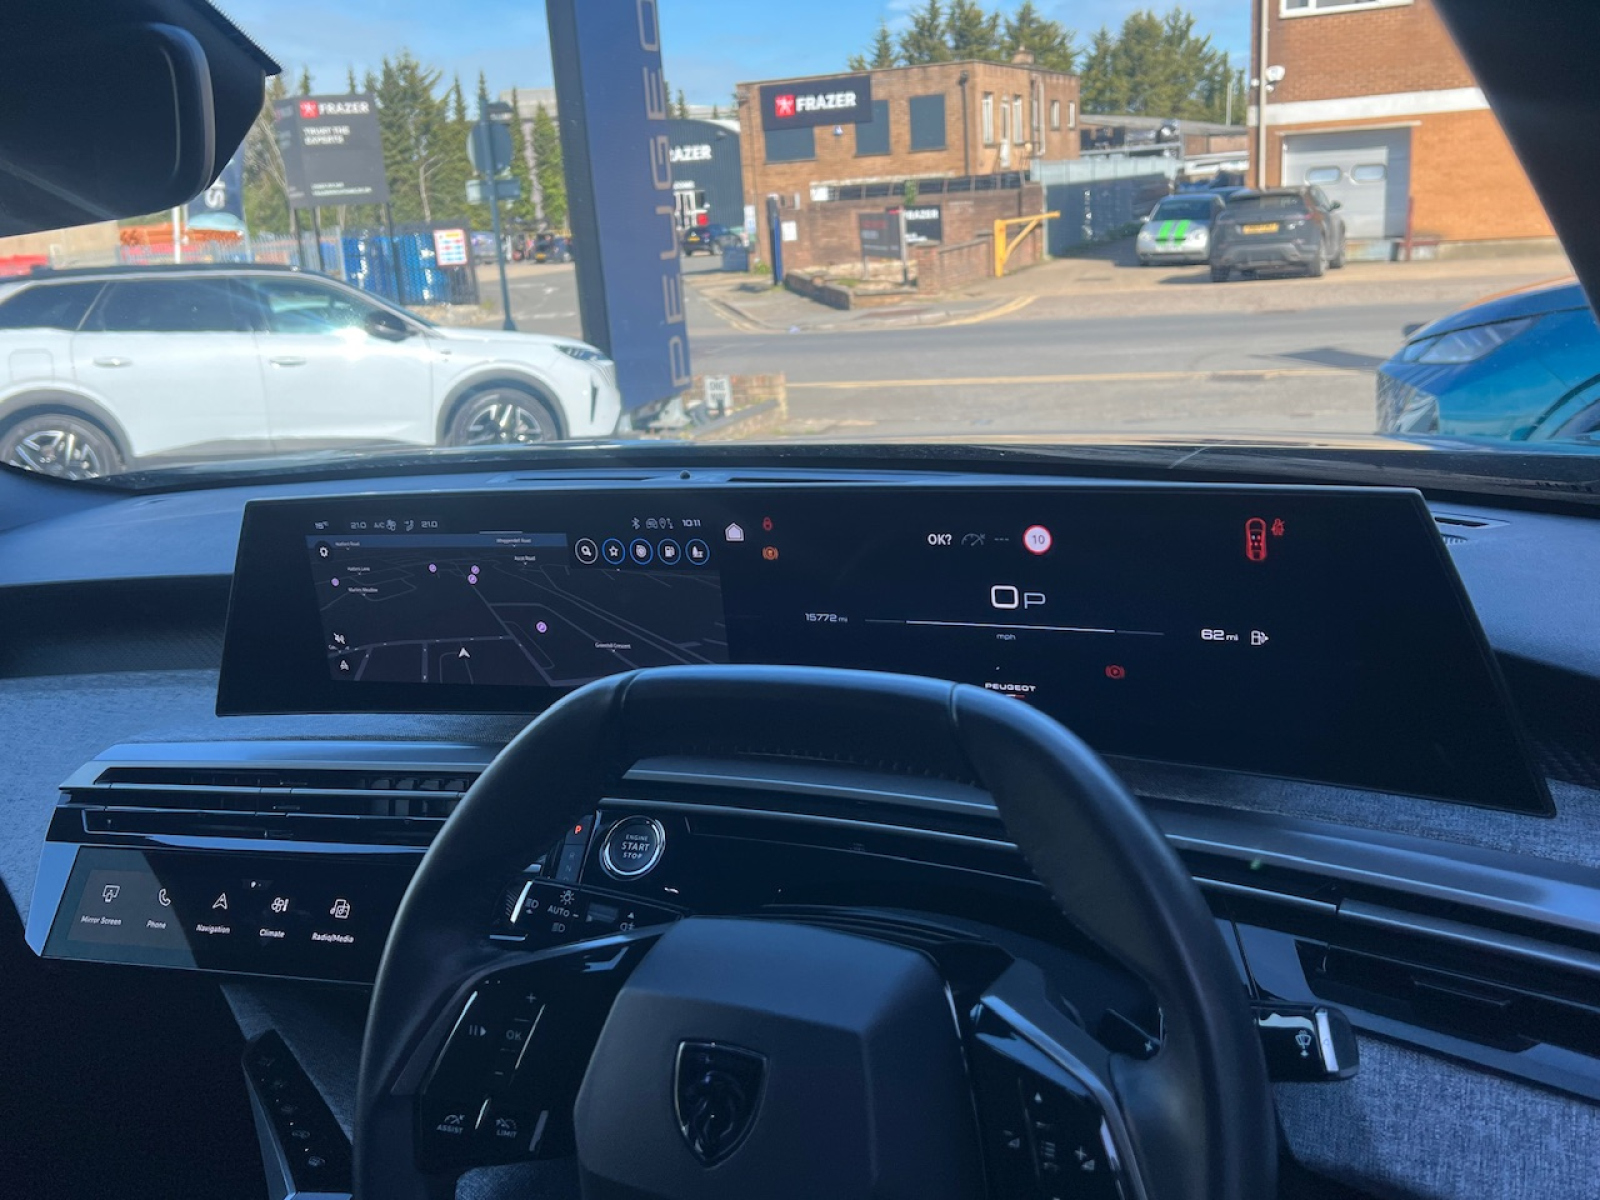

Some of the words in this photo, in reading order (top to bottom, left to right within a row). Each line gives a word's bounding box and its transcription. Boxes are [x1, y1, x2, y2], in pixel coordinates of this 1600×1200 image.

[795, 92, 856, 112] FRAZER
[318, 101, 370, 115] FRAZER
[927, 533, 952, 546] OK?
[1032, 534, 1045, 545] 10
[804, 613, 837, 622] 15772
[996, 633, 1017, 641] mph
[1200, 628, 1225, 641] 62
[984, 682, 1037, 692] PEUGEOT
[625, 834, 649, 842] ENGINE
[620, 841, 650, 852] START
[622, 851, 643, 860] STOP
[547, 903, 571, 919] AUTO
[80, 915, 101, 924] Mirror
[100, 917, 122, 926] Screen
[146, 919, 166, 930] Phone
[195, 924, 231, 935] Navigation
[258, 928, 285, 938] Climate
[504, 1028, 521, 1041] OK
